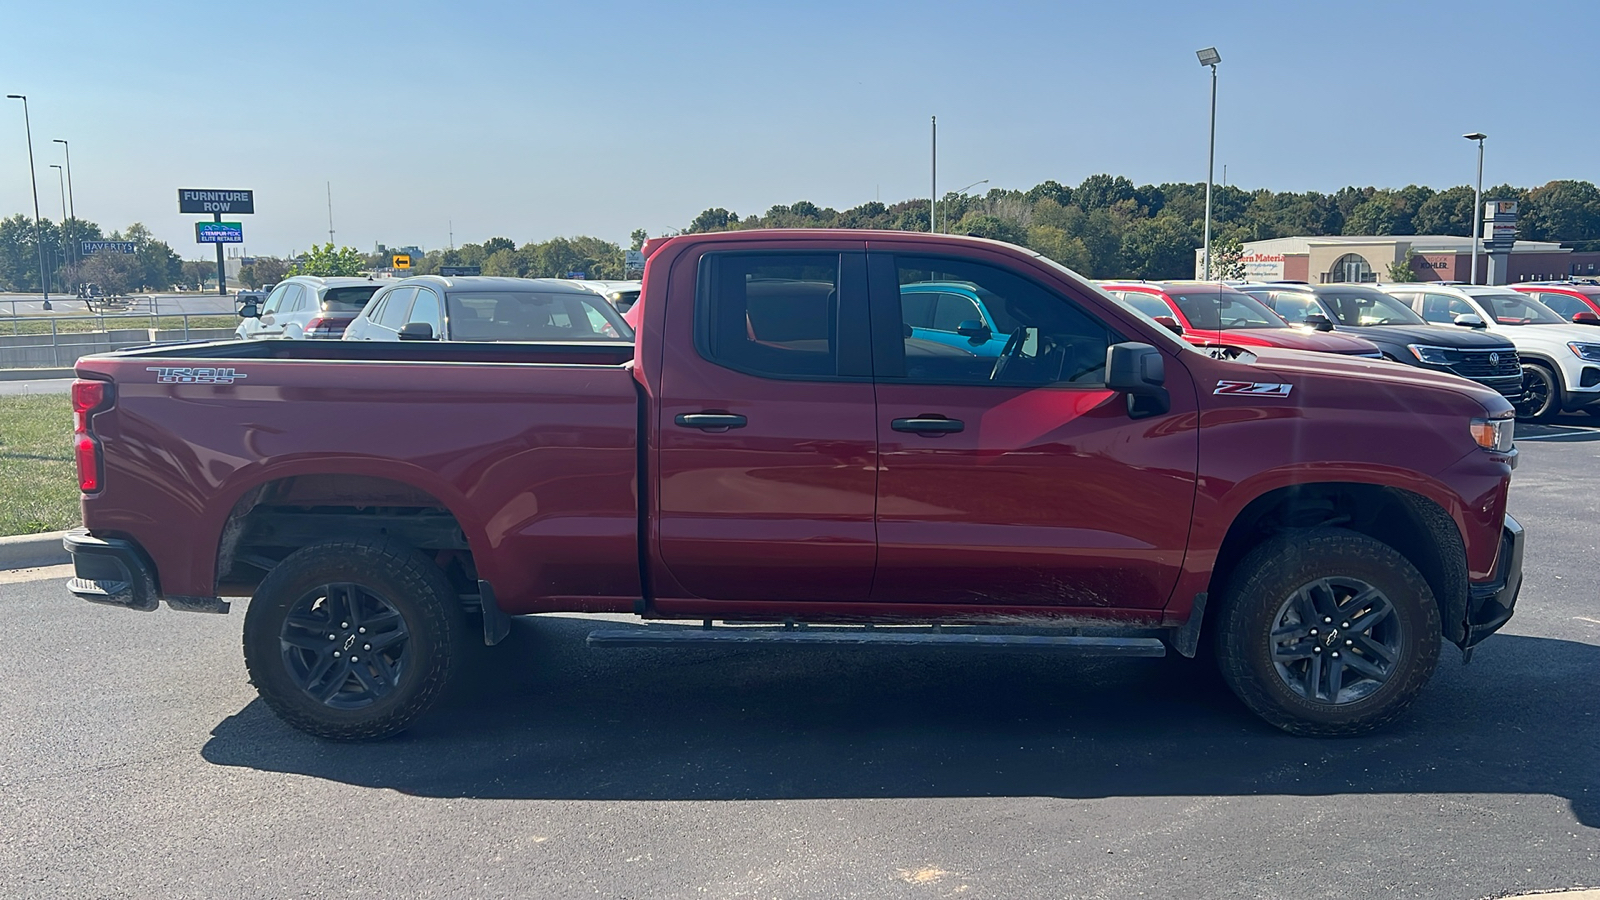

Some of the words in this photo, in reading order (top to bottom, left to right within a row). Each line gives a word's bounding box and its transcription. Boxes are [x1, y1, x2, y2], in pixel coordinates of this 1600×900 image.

[184, 191, 248, 201] FURNITURE
[203, 202, 231, 211] ROW
[146, 366, 247, 378] TRAIL
[157, 376, 235, 384] BOSS
